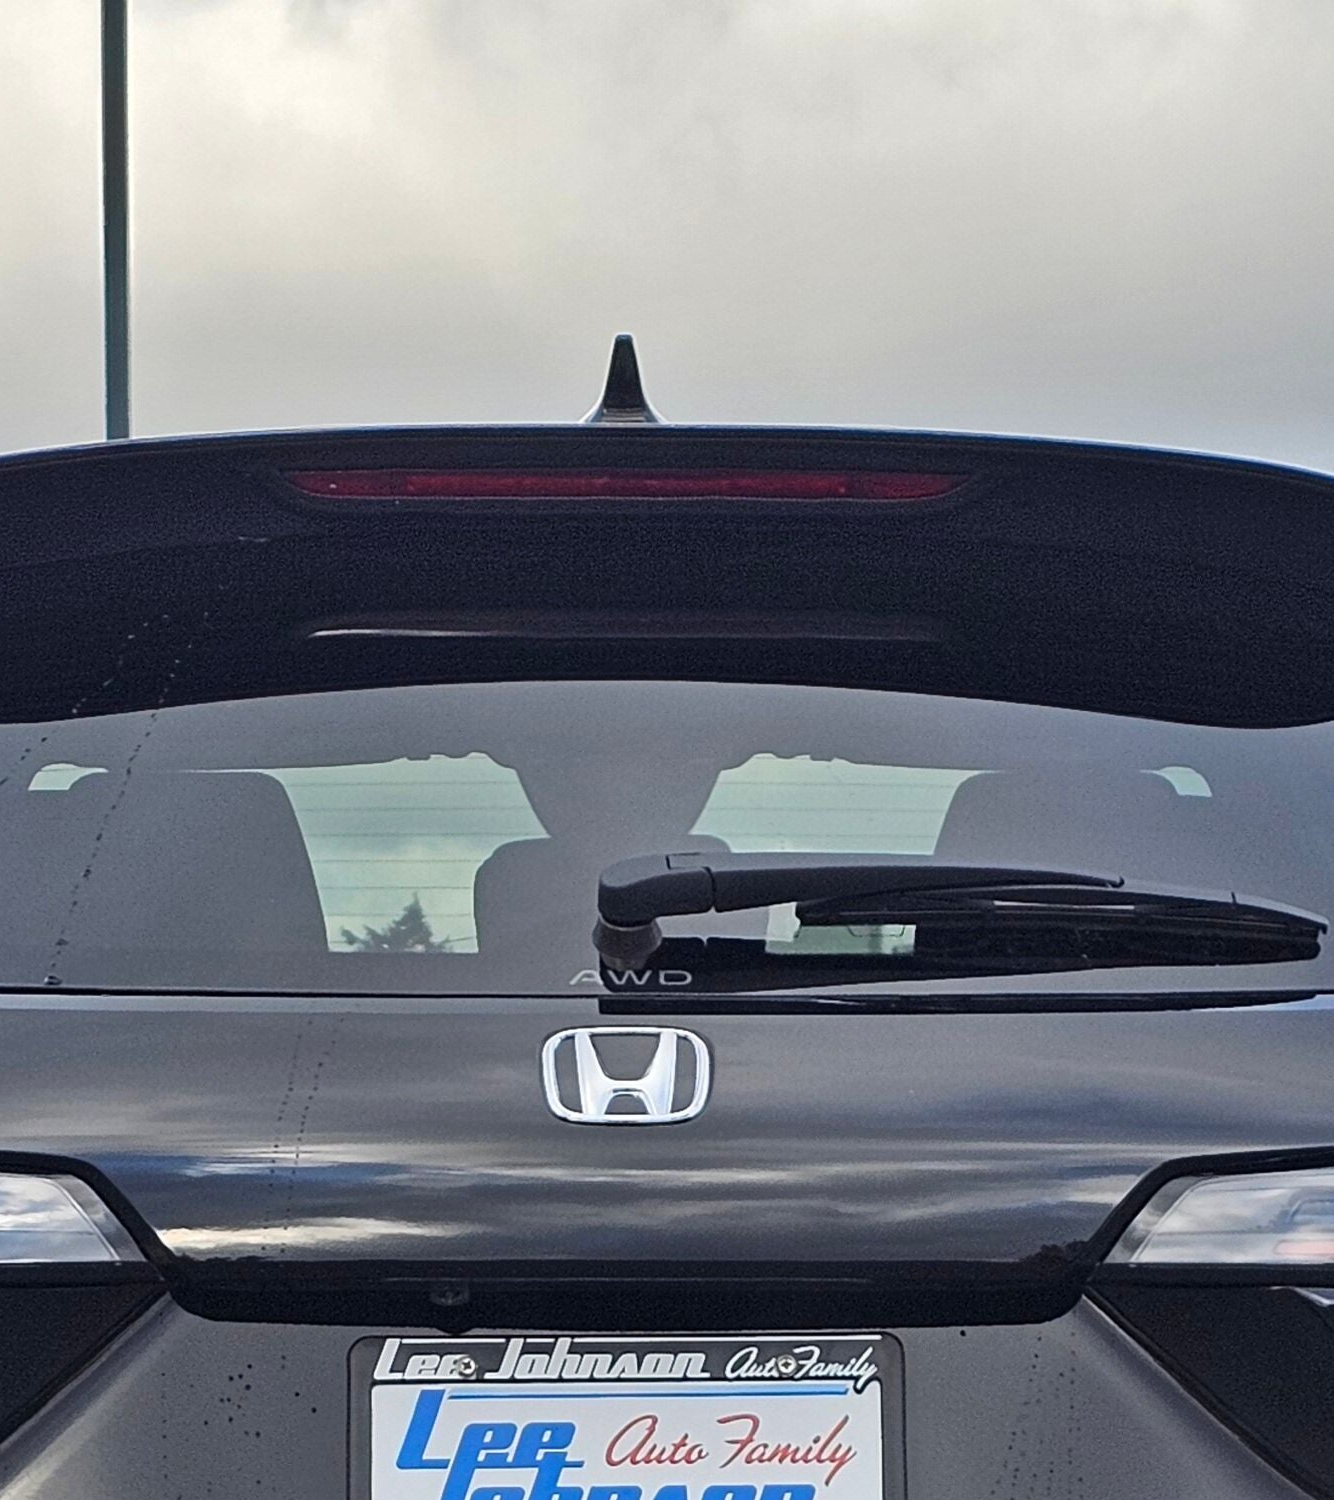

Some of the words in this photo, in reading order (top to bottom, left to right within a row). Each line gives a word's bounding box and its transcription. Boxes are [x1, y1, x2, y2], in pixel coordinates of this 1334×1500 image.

[569, 969, 693, 986] AWD
[483, 1337, 711, 1380] Johnson
[725, 1346, 794, 1380] Aut
[793, 1345, 878, 1390] Family
[395, 1389, 585, 1470] Lee
[605, 1414, 708, 1467] Auto
[716, 1413, 857, 1487] Family
